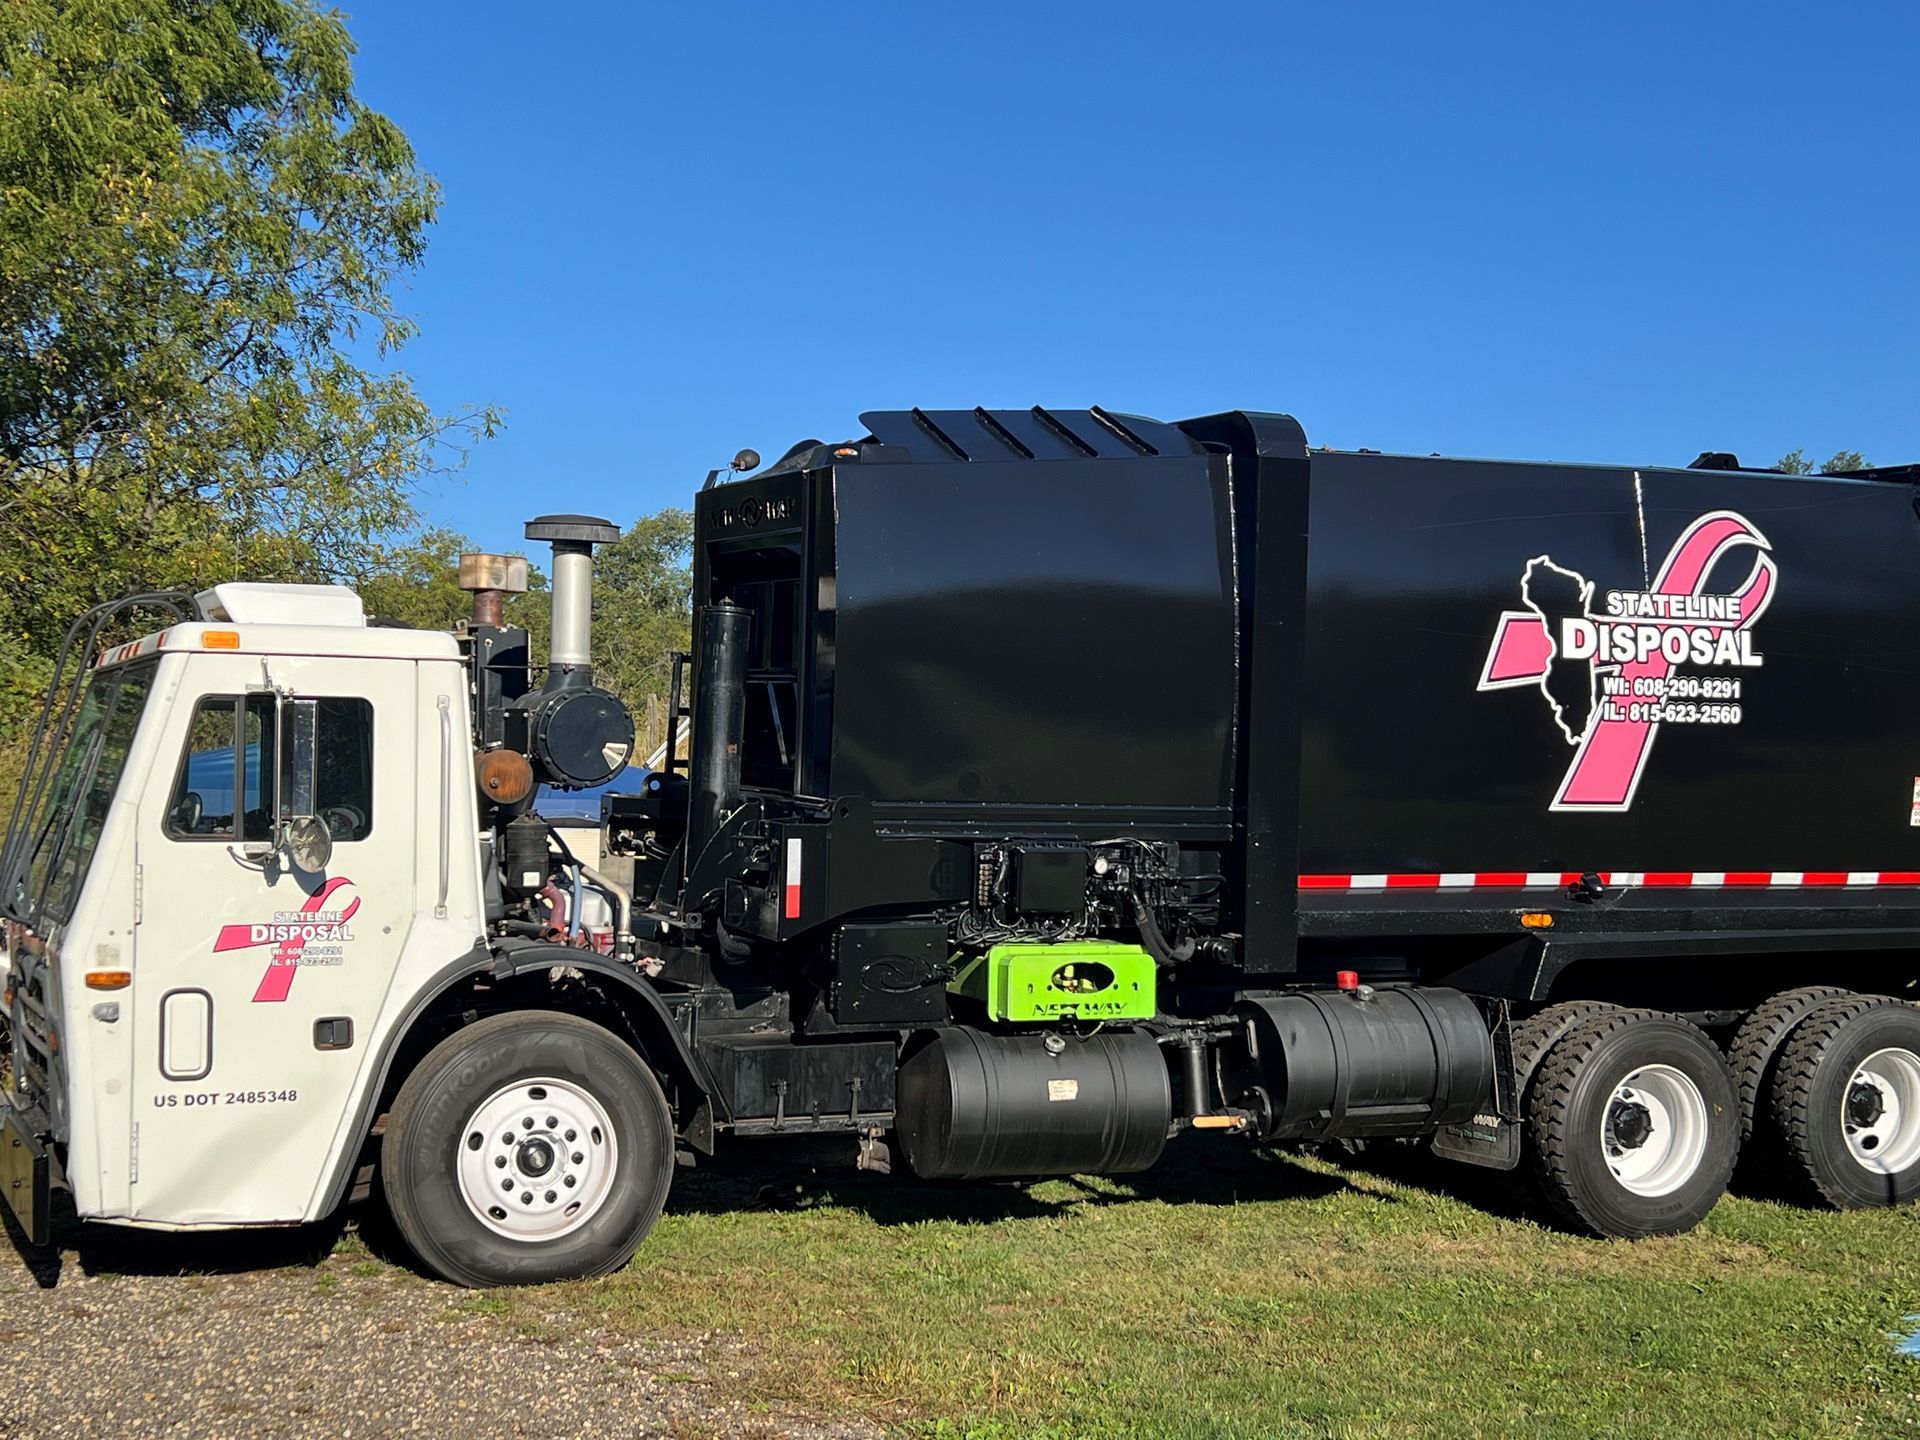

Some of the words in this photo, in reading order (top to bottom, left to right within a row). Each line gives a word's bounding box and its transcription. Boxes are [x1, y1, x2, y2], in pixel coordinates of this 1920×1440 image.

[1607, 592, 1742, 619] STATELINE
[1562, 617, 1763, 666] DISPOSAL
[1603, 677, 1630, 696] WI:
[1633, 677, 1741, 698] 608-290-8291
[1603, 703, 1627, 721] IL:
[1629, 703, 1742, 723] 815-623-2560
[274, 911, 344, 922] STATELINE
[250, 924, 355, 942] DISPOSAL
[1084, 1002, 1128, 1016] WAY
[154, 1095, 178, 1107] US
[184, 1093, 220, 1106] DOT
[225, 1090, 298, 1105] 2485348
[1472, 1114, 1501, 1128] WAY
